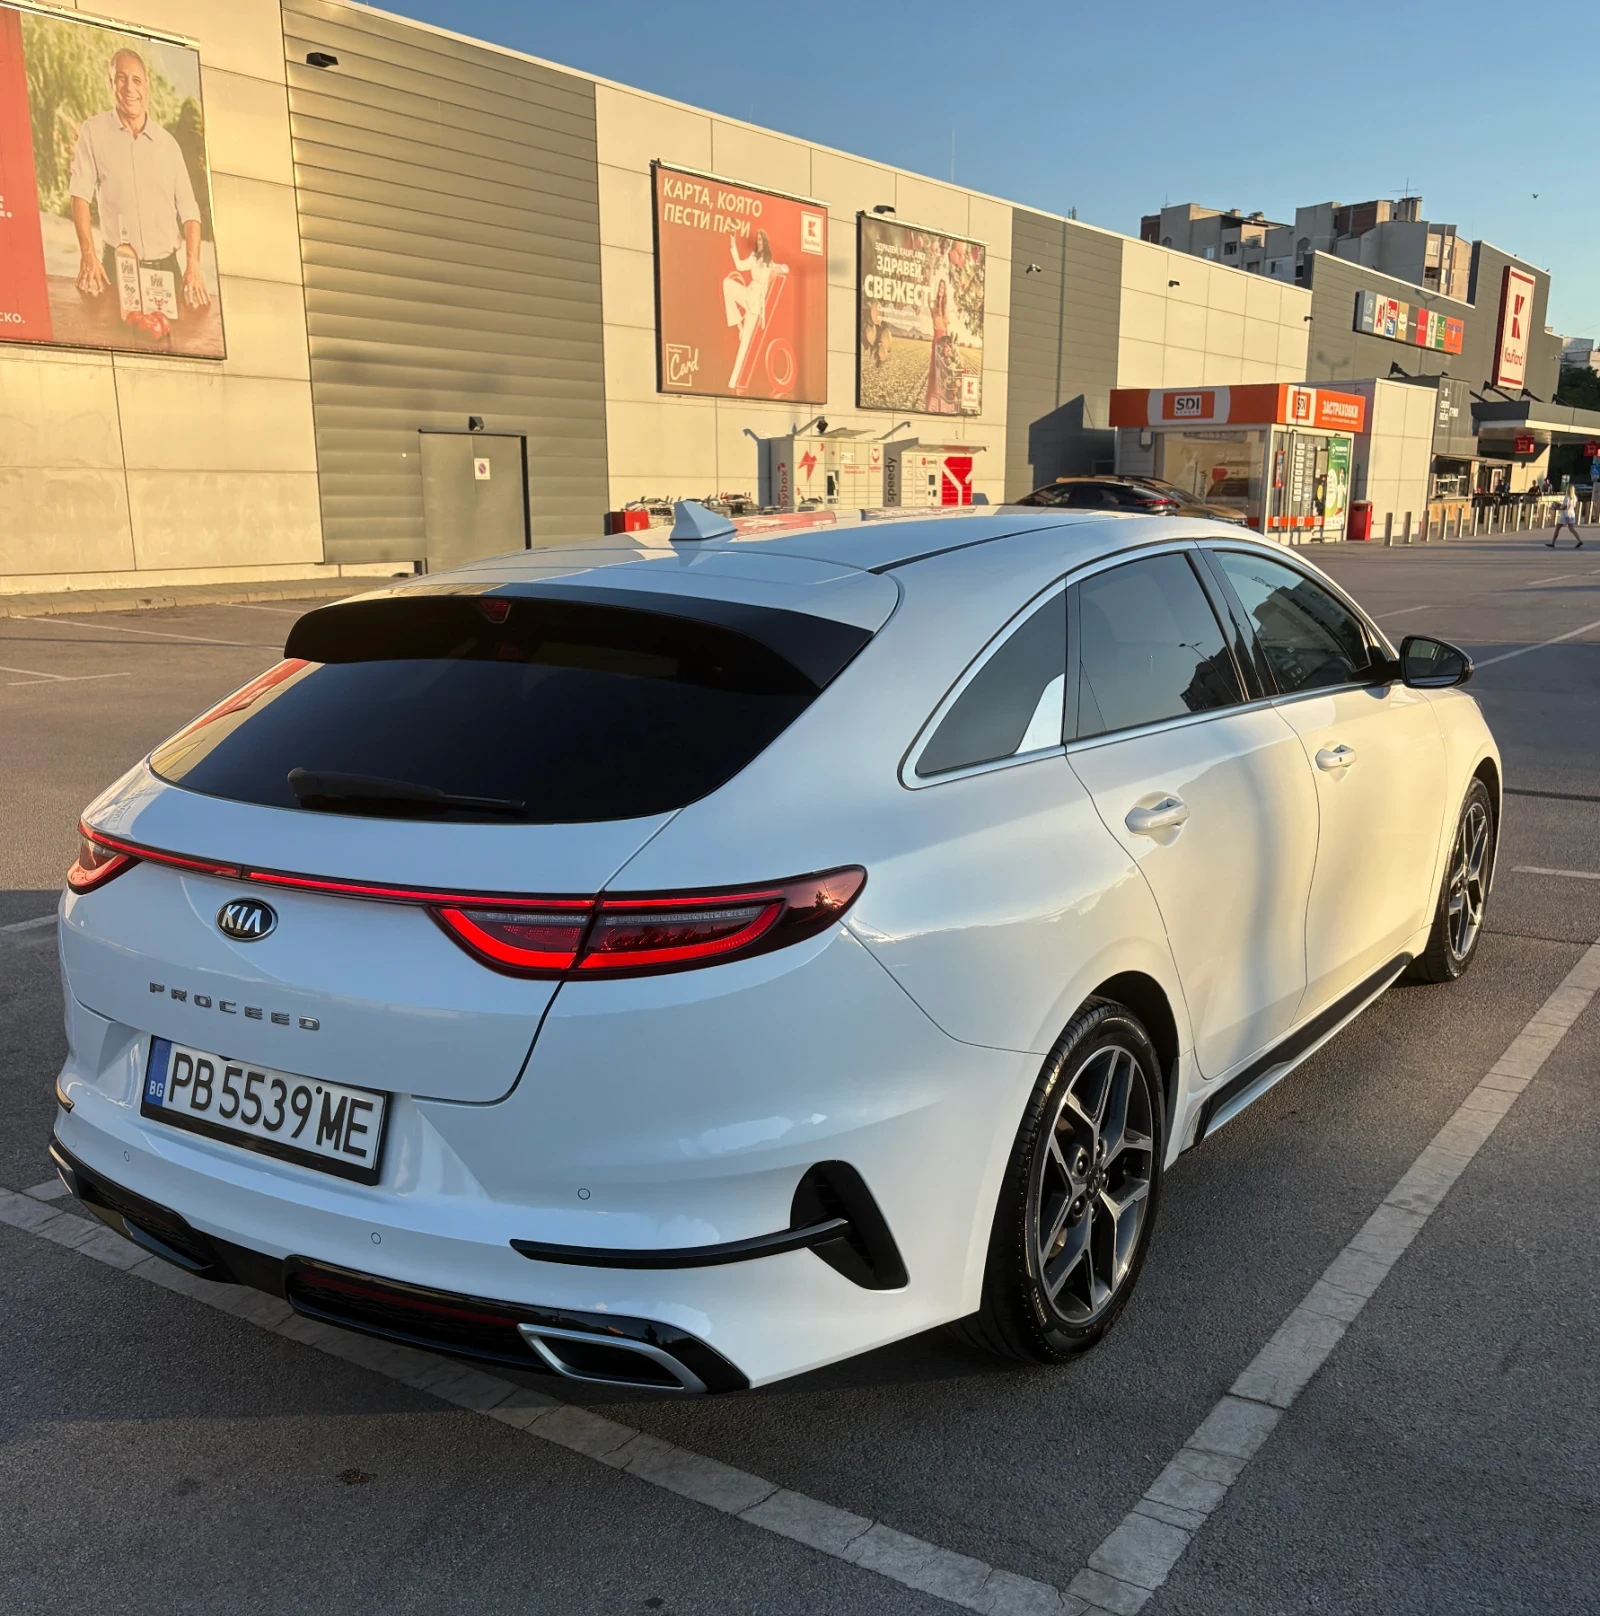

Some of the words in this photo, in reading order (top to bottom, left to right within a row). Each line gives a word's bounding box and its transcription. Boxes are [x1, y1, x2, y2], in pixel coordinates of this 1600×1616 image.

[663, 177, 714, 210] КАРТА,
[717, 190, 763, 218] КОЯТО
[664, 202, 711, 230] ПЕСТИ
[876, 254, 924, 282] ЗДРАВЕЙ,
[0, 311, 26, 324] КО.
[1511, 293, 1525, 340] K
[670, 347, 699, 381] Card
[1176, 397, 1200, 410] SDI
[781, 470, 790, 506] sybox
[885, 457, 899, 503] speedy
[221, 904, 262, 934] KIA
[149, 981, 321, 1031] PROCEED
[149, 1080, 164, 1098] BG
[219, 1065, 313, 1139] 5539
